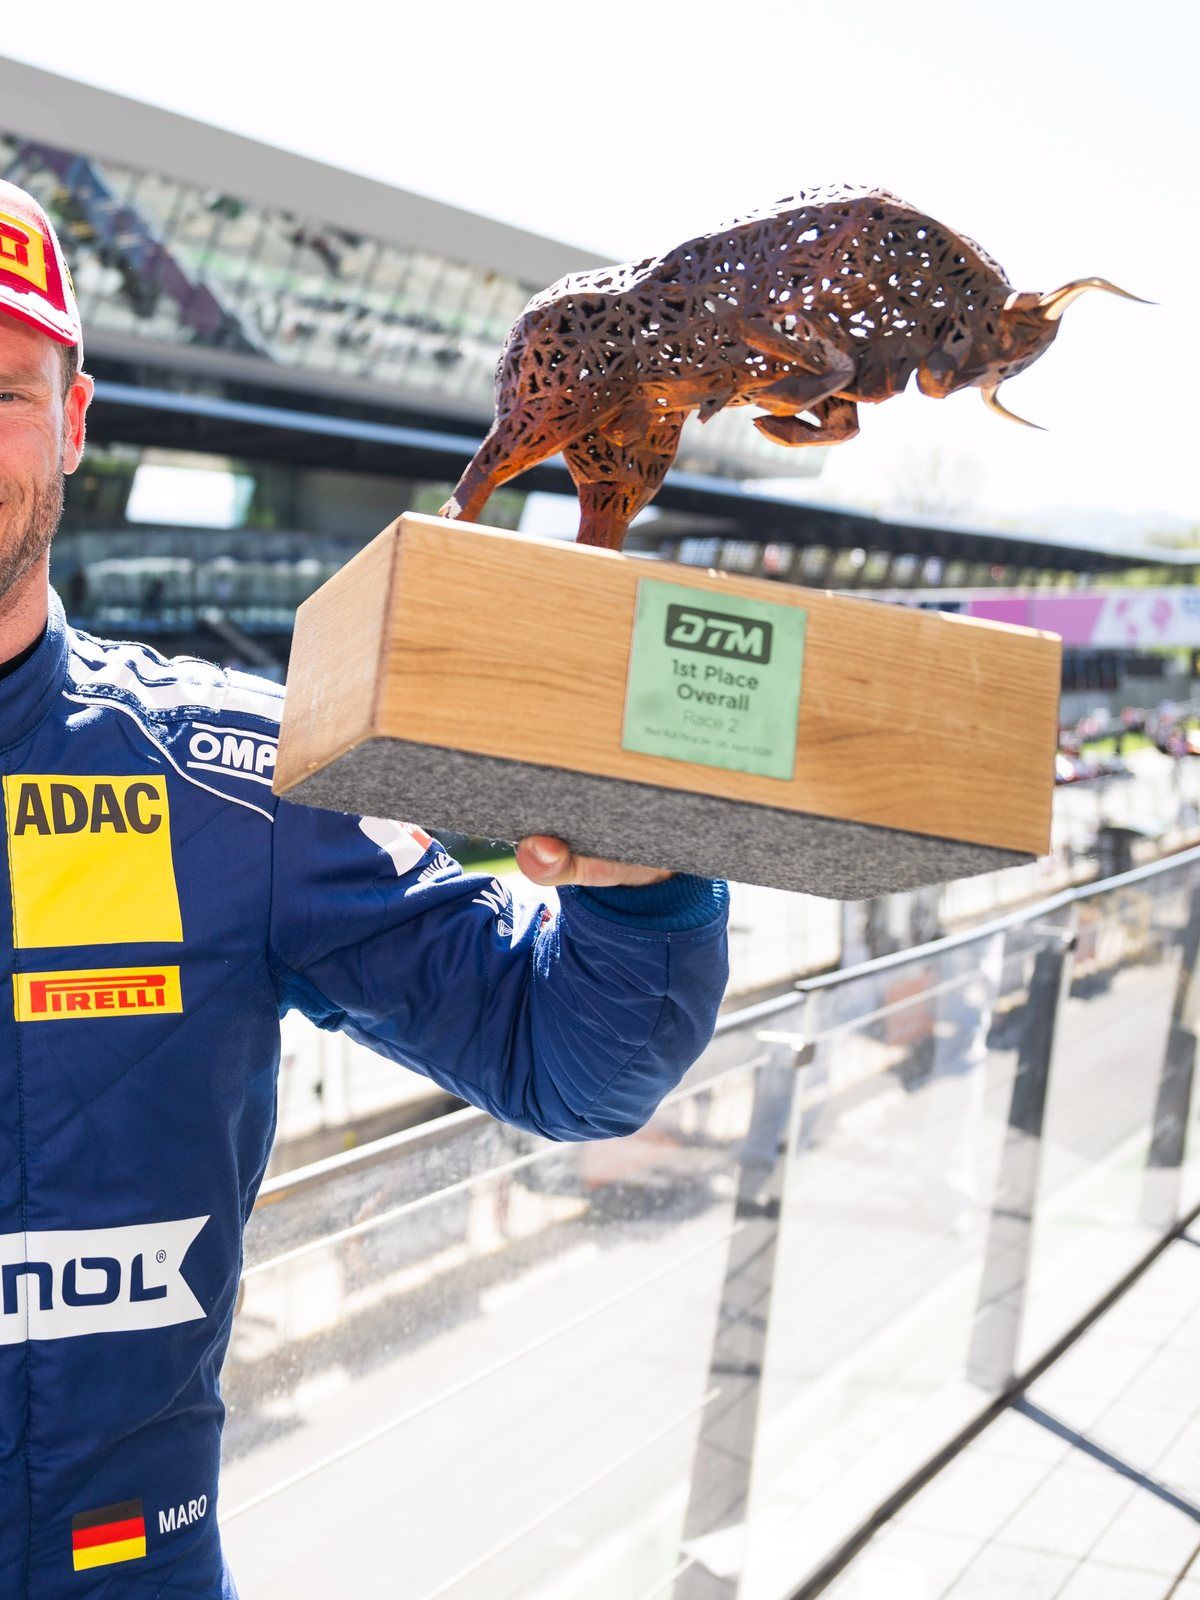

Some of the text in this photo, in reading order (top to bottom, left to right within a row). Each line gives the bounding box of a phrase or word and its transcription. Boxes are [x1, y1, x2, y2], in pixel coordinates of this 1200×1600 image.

[671, 613, 764, 657] DTM
[671, 659, 759, 690] 1st Place
[676, 683, 750, 712] Overall
[682, 709, 740, 734] Race 2
[189, 732, 278, 774] OMP
[14, 782, 162, 836] ADAC
[29, 974, 167, 1013] PIRELLI
[158, 1494, 208, 1534] MARO
